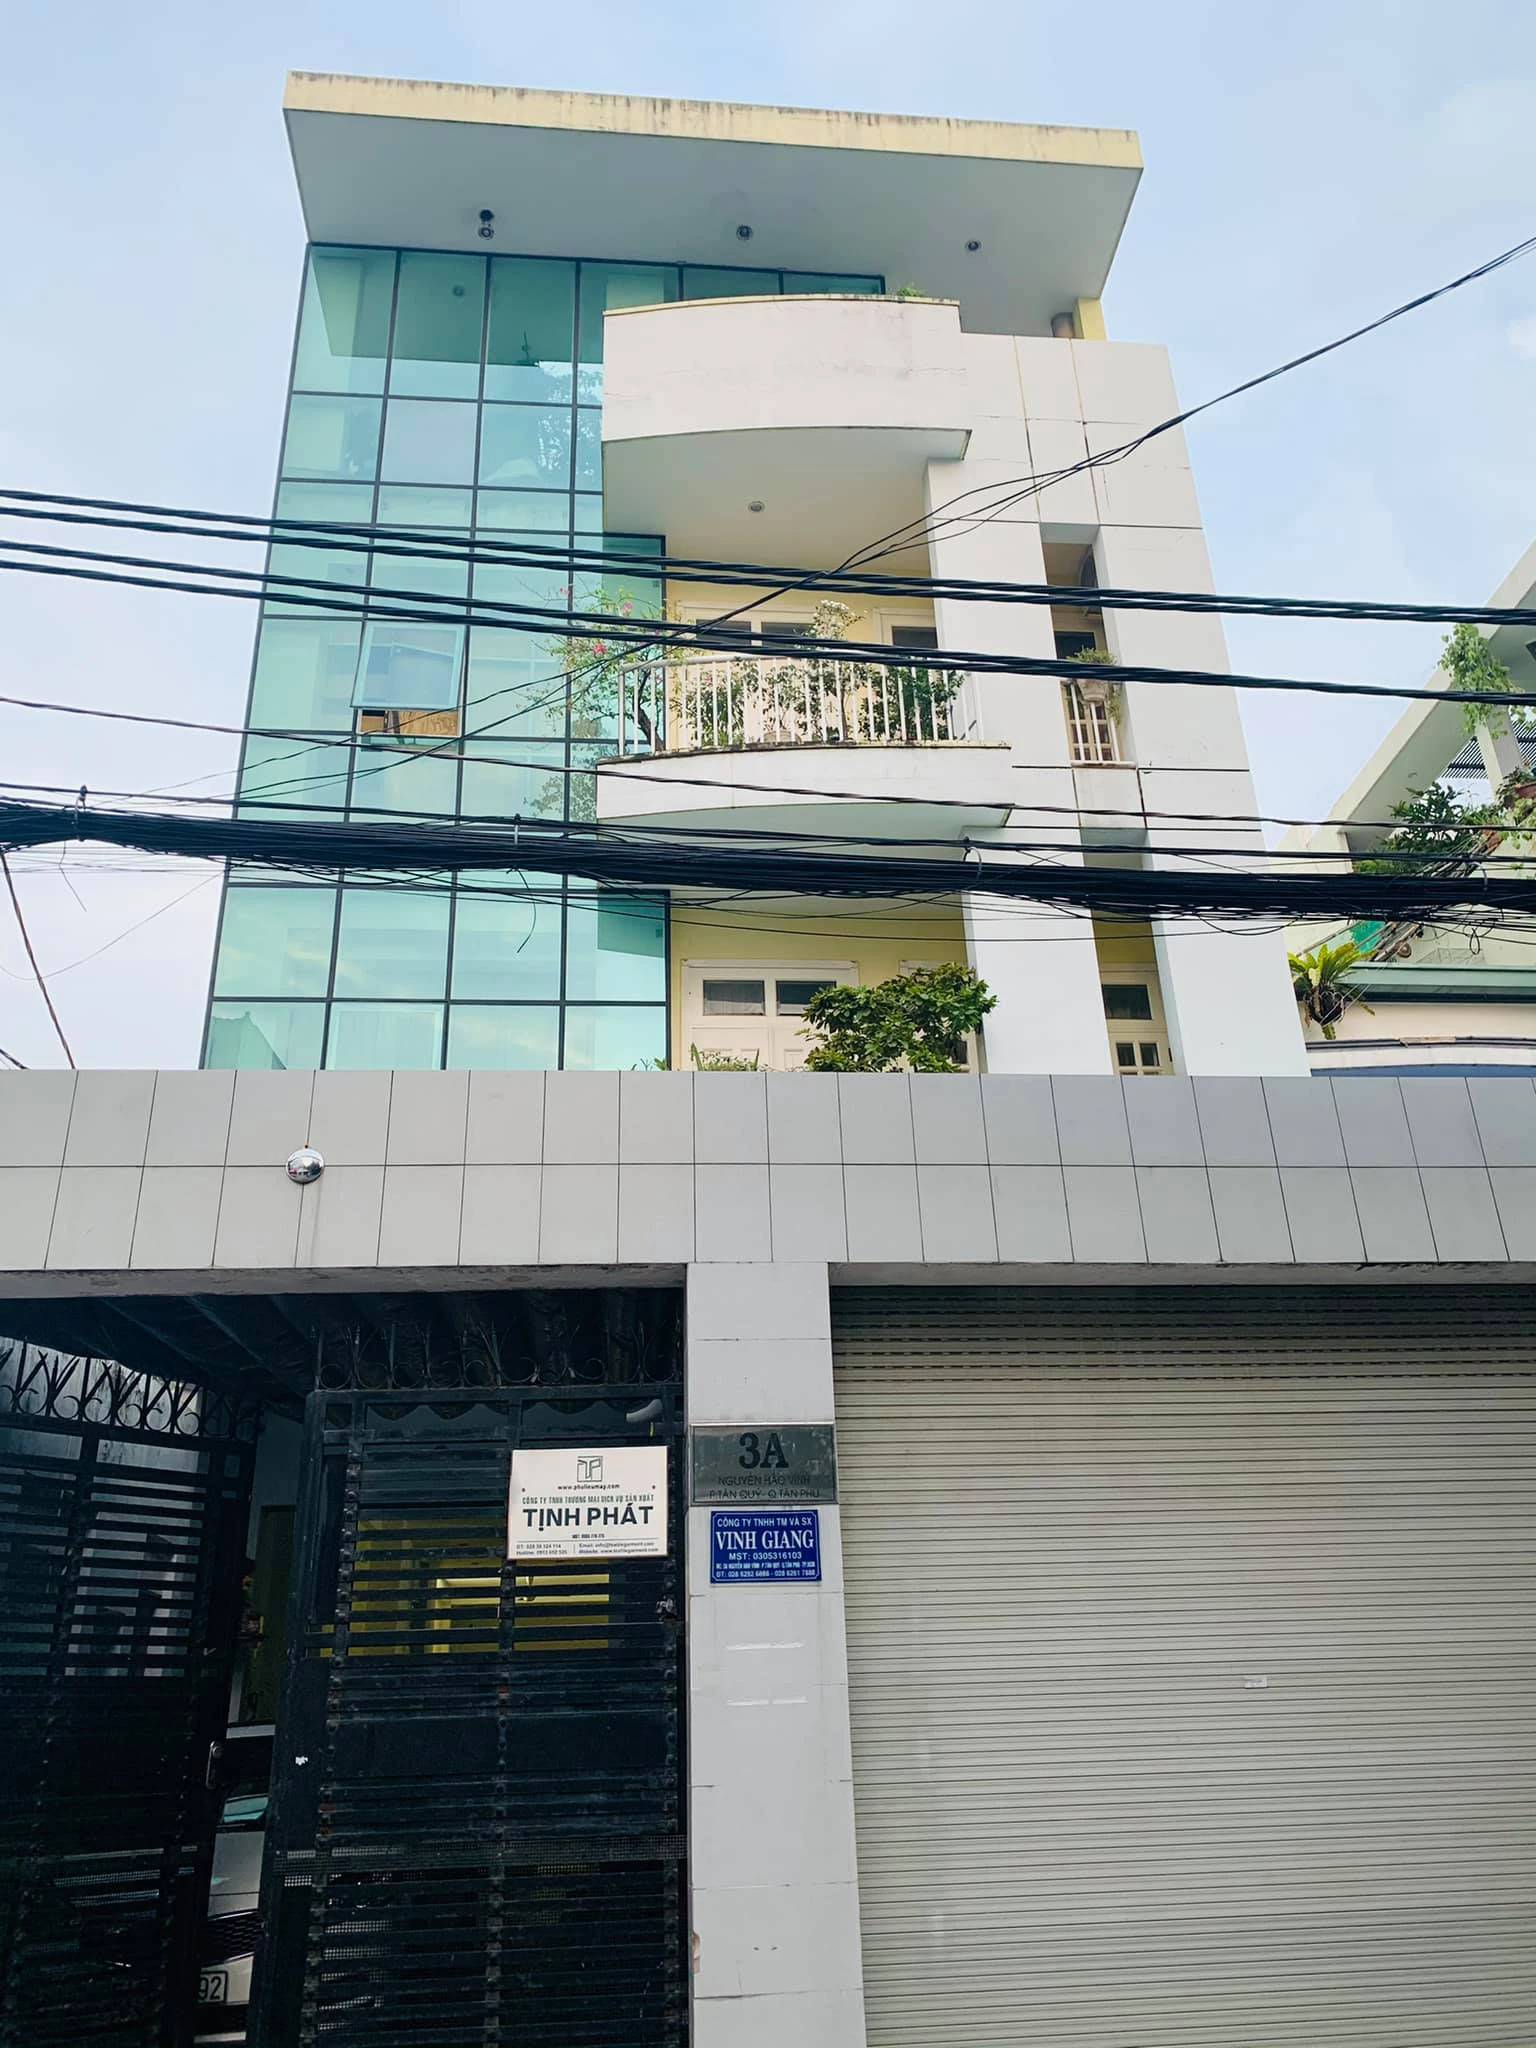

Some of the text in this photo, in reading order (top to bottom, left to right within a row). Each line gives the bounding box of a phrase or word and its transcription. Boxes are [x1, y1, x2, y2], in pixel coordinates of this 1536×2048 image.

[738, 1432, 789, 1469] 3A
[540, 1496, 547, 1504] TY
[523, 1502, 653, 1531] TỊNH PHÁT
[717, 1515, 813, 1528] CÔNG TY TNHH TM VÀ SX
[716, 1529, 814, 1550] VINH GIANG
[729, 1551, 802, 1561] MST: 0305316103
